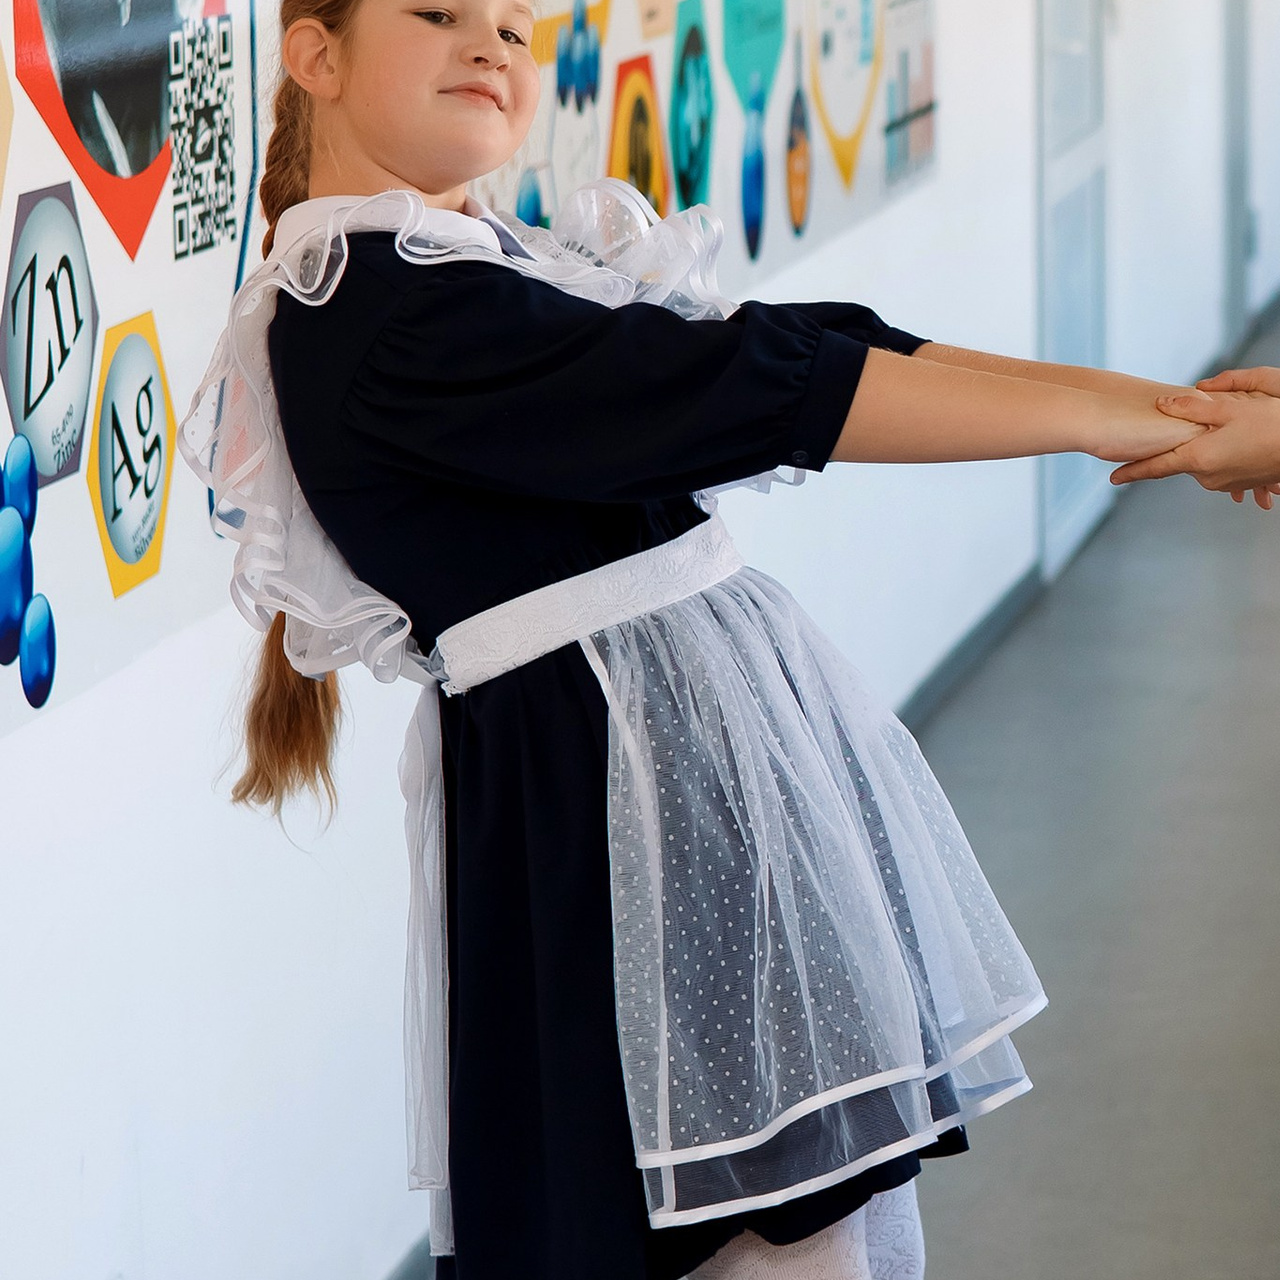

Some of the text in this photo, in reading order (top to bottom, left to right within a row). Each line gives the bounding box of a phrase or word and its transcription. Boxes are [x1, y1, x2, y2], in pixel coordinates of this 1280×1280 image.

[12, 252, 83, 421] Zn
[53, 428, 77, 474] Zinc
[111, 374, 164, 525] Ag
